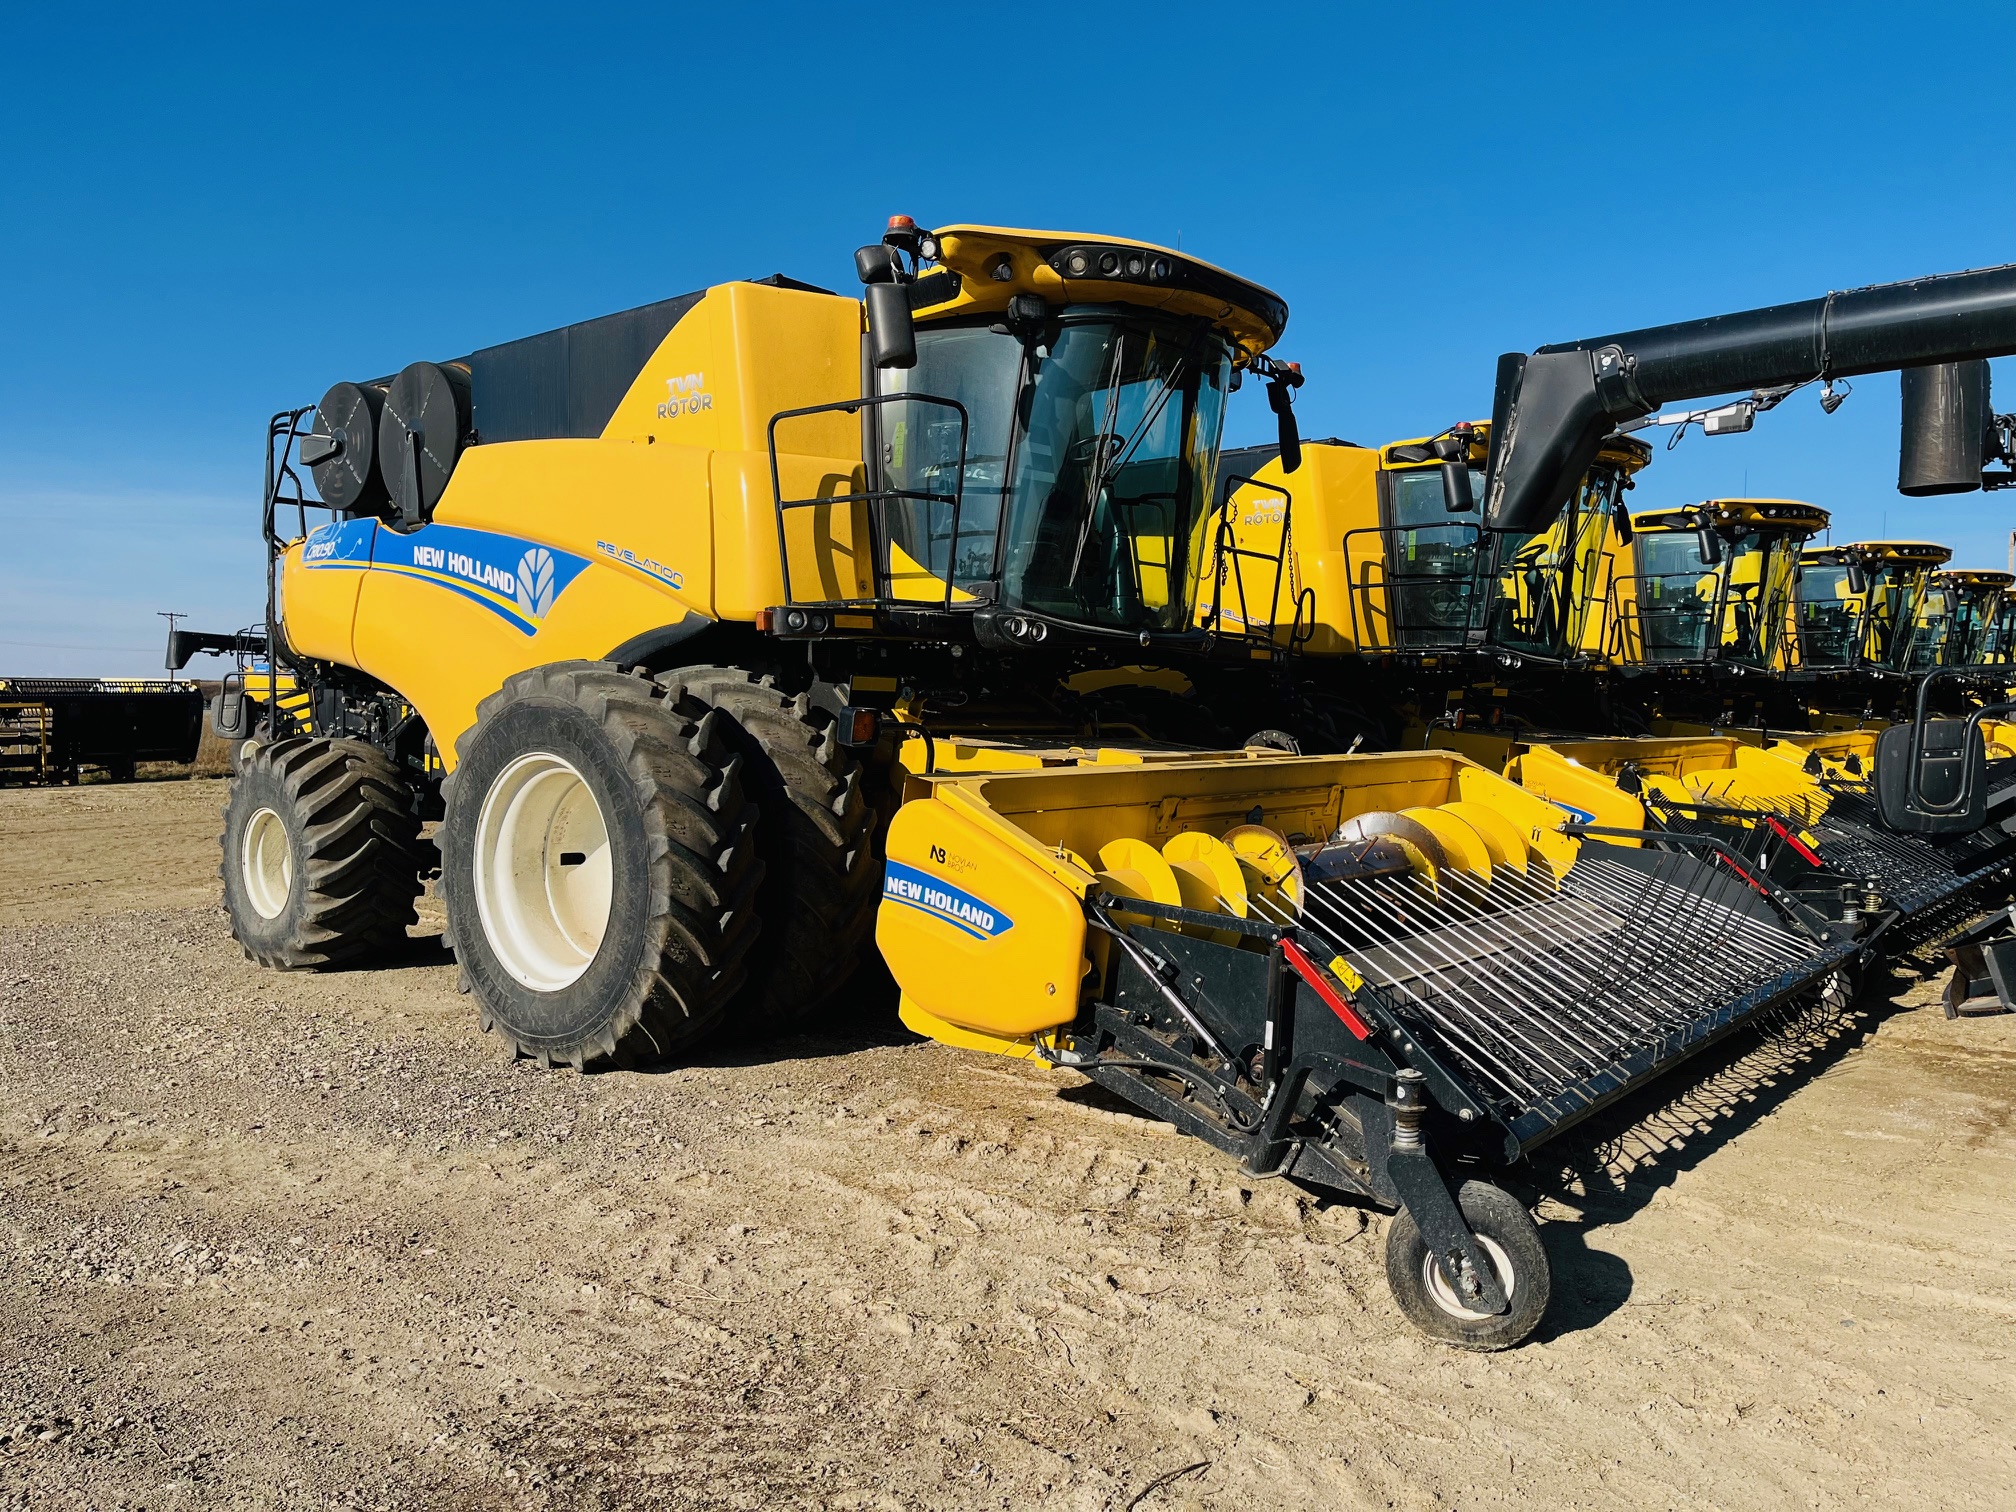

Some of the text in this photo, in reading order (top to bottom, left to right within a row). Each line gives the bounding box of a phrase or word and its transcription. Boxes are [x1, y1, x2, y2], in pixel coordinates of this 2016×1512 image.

[666, 372, 703, 394] TWIN
[657, 391, 712, 419] ROTOR
[1253, 498, 1284, 510] TWIN
[1244, 511, 1286, 526] ROTO
[413, 545, 515, 594] NEW HOLLAND
[597, 540, 684, 585] REVELATION
[929, 844, 946, 864] NB
[887, 876, 994, 931] NEW HOLLAND
